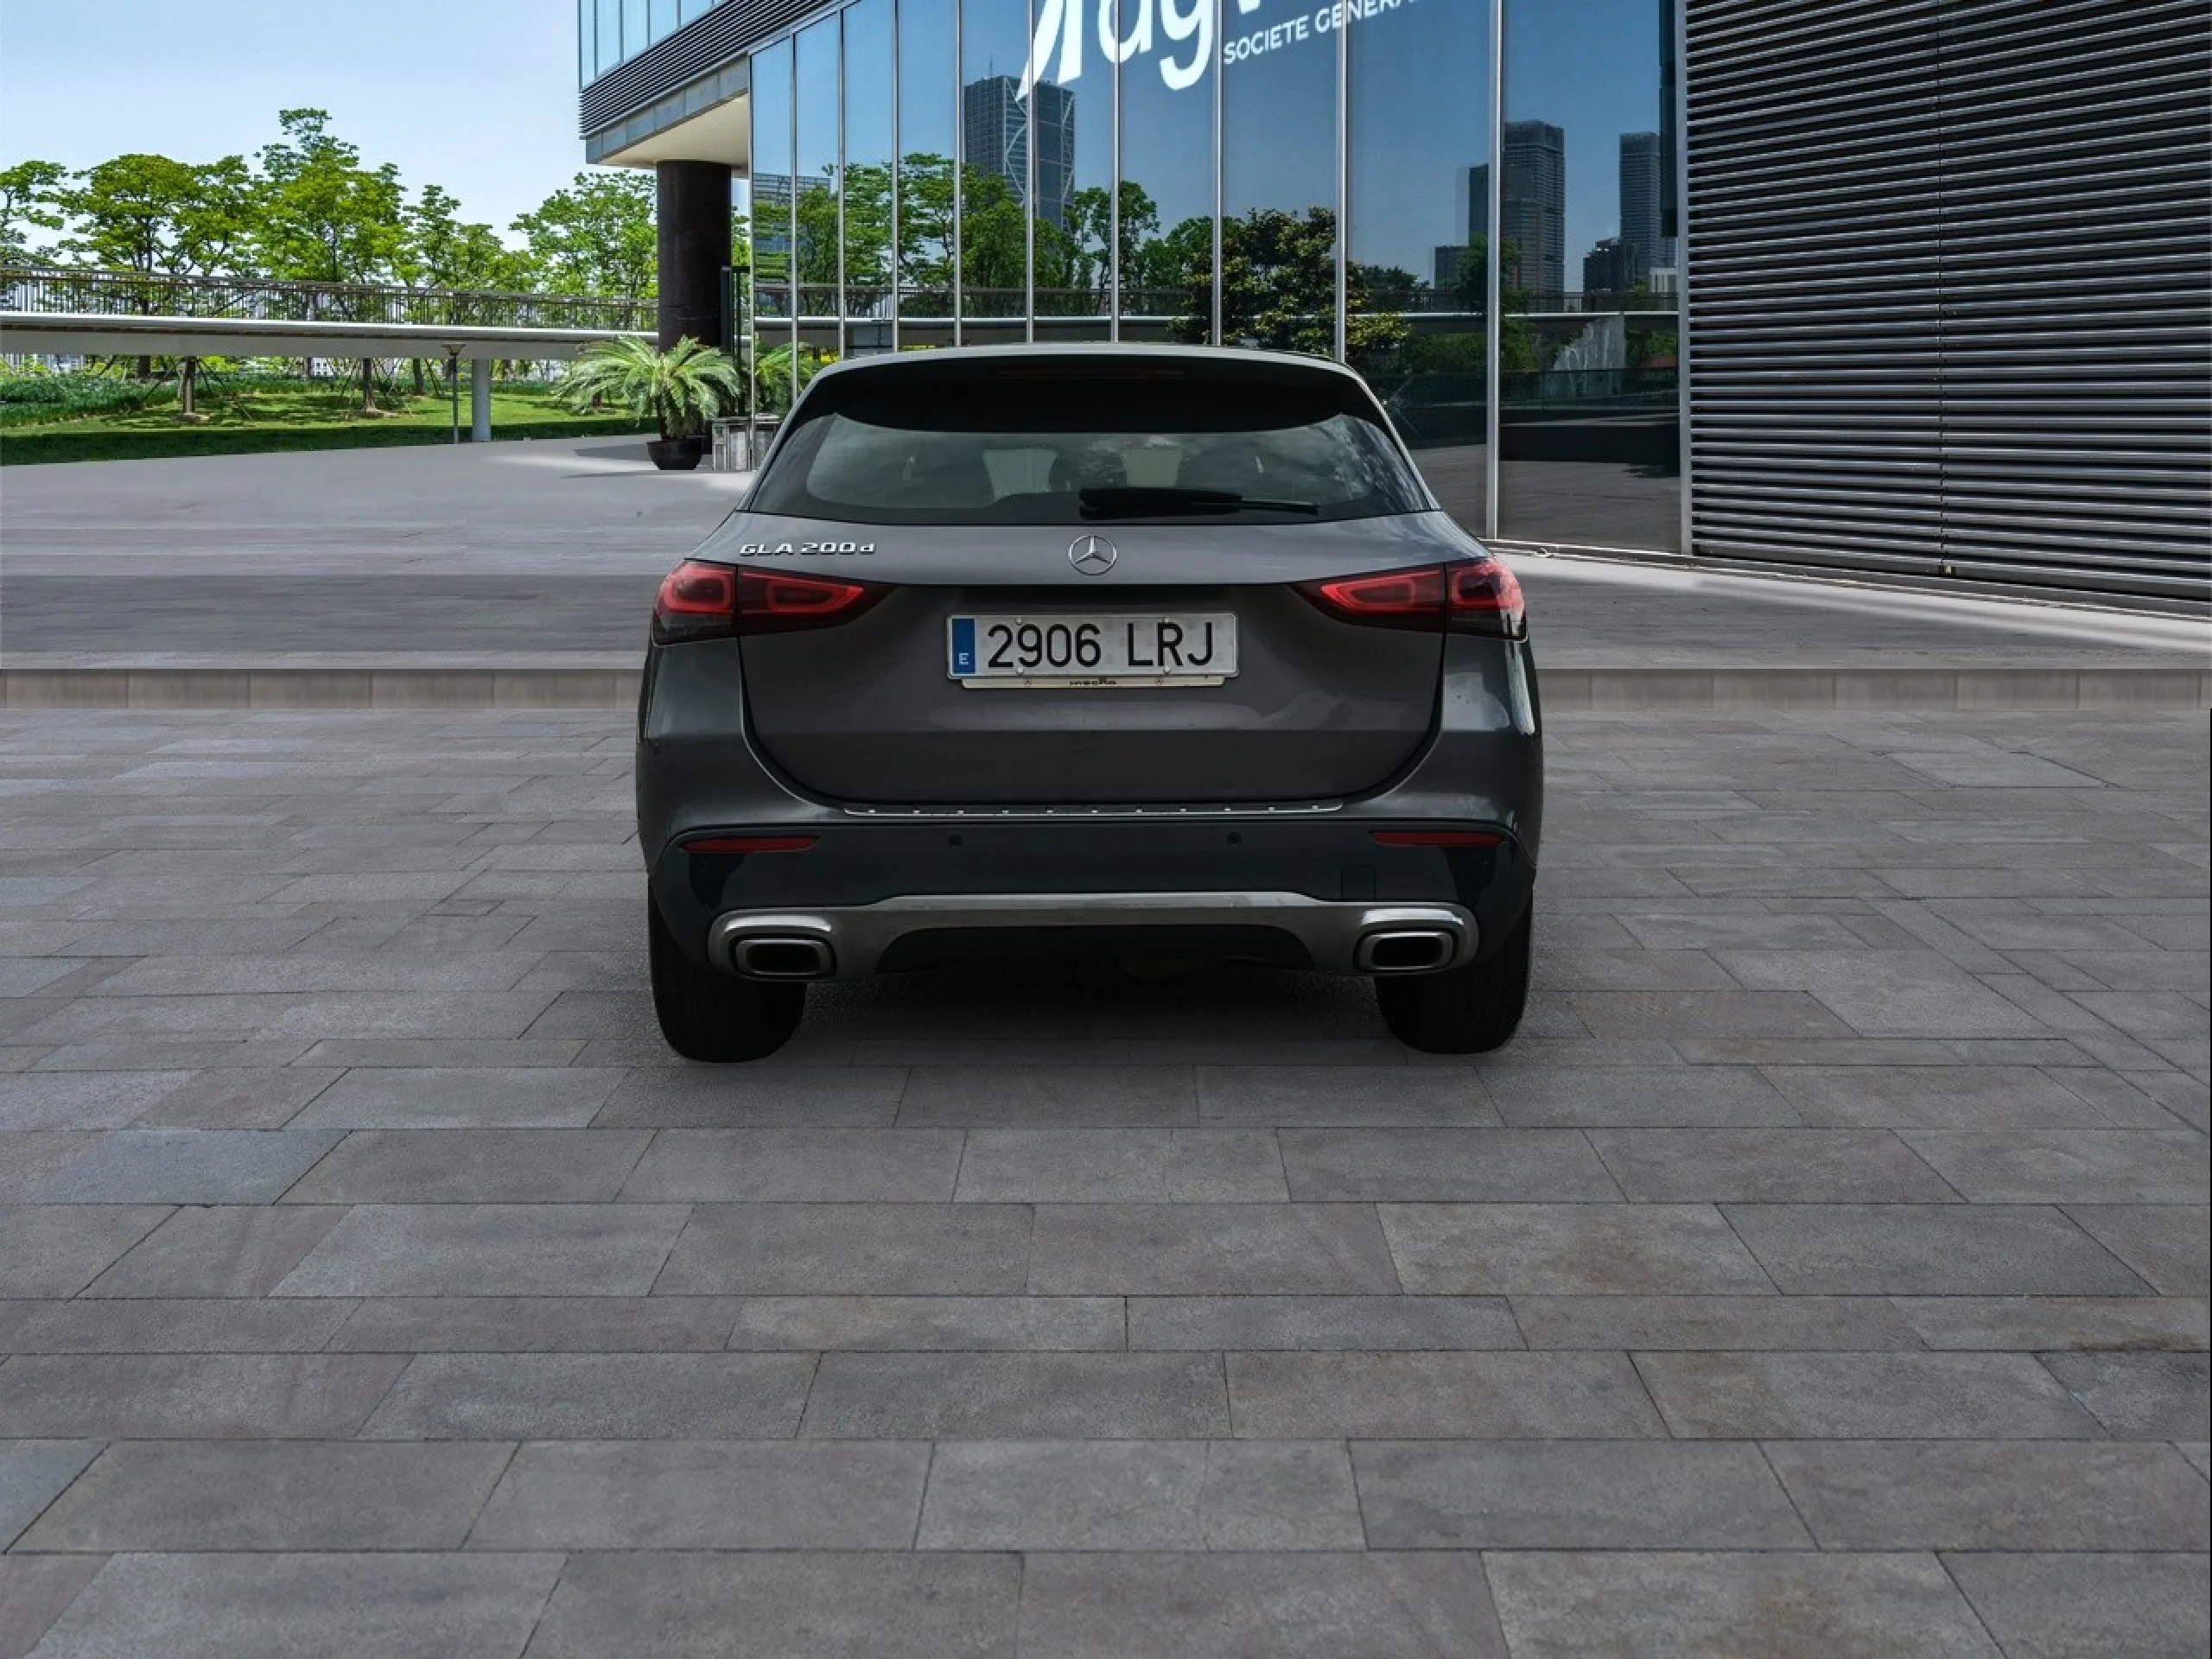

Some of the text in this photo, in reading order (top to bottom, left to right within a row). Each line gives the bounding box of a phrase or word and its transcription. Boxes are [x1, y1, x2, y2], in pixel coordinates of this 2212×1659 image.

[1224, 15, 1310, 65] SOCIETE
[740, 543, 794, 556] GLA
[958, 621, 1212, 668] E 2906 LRJ
